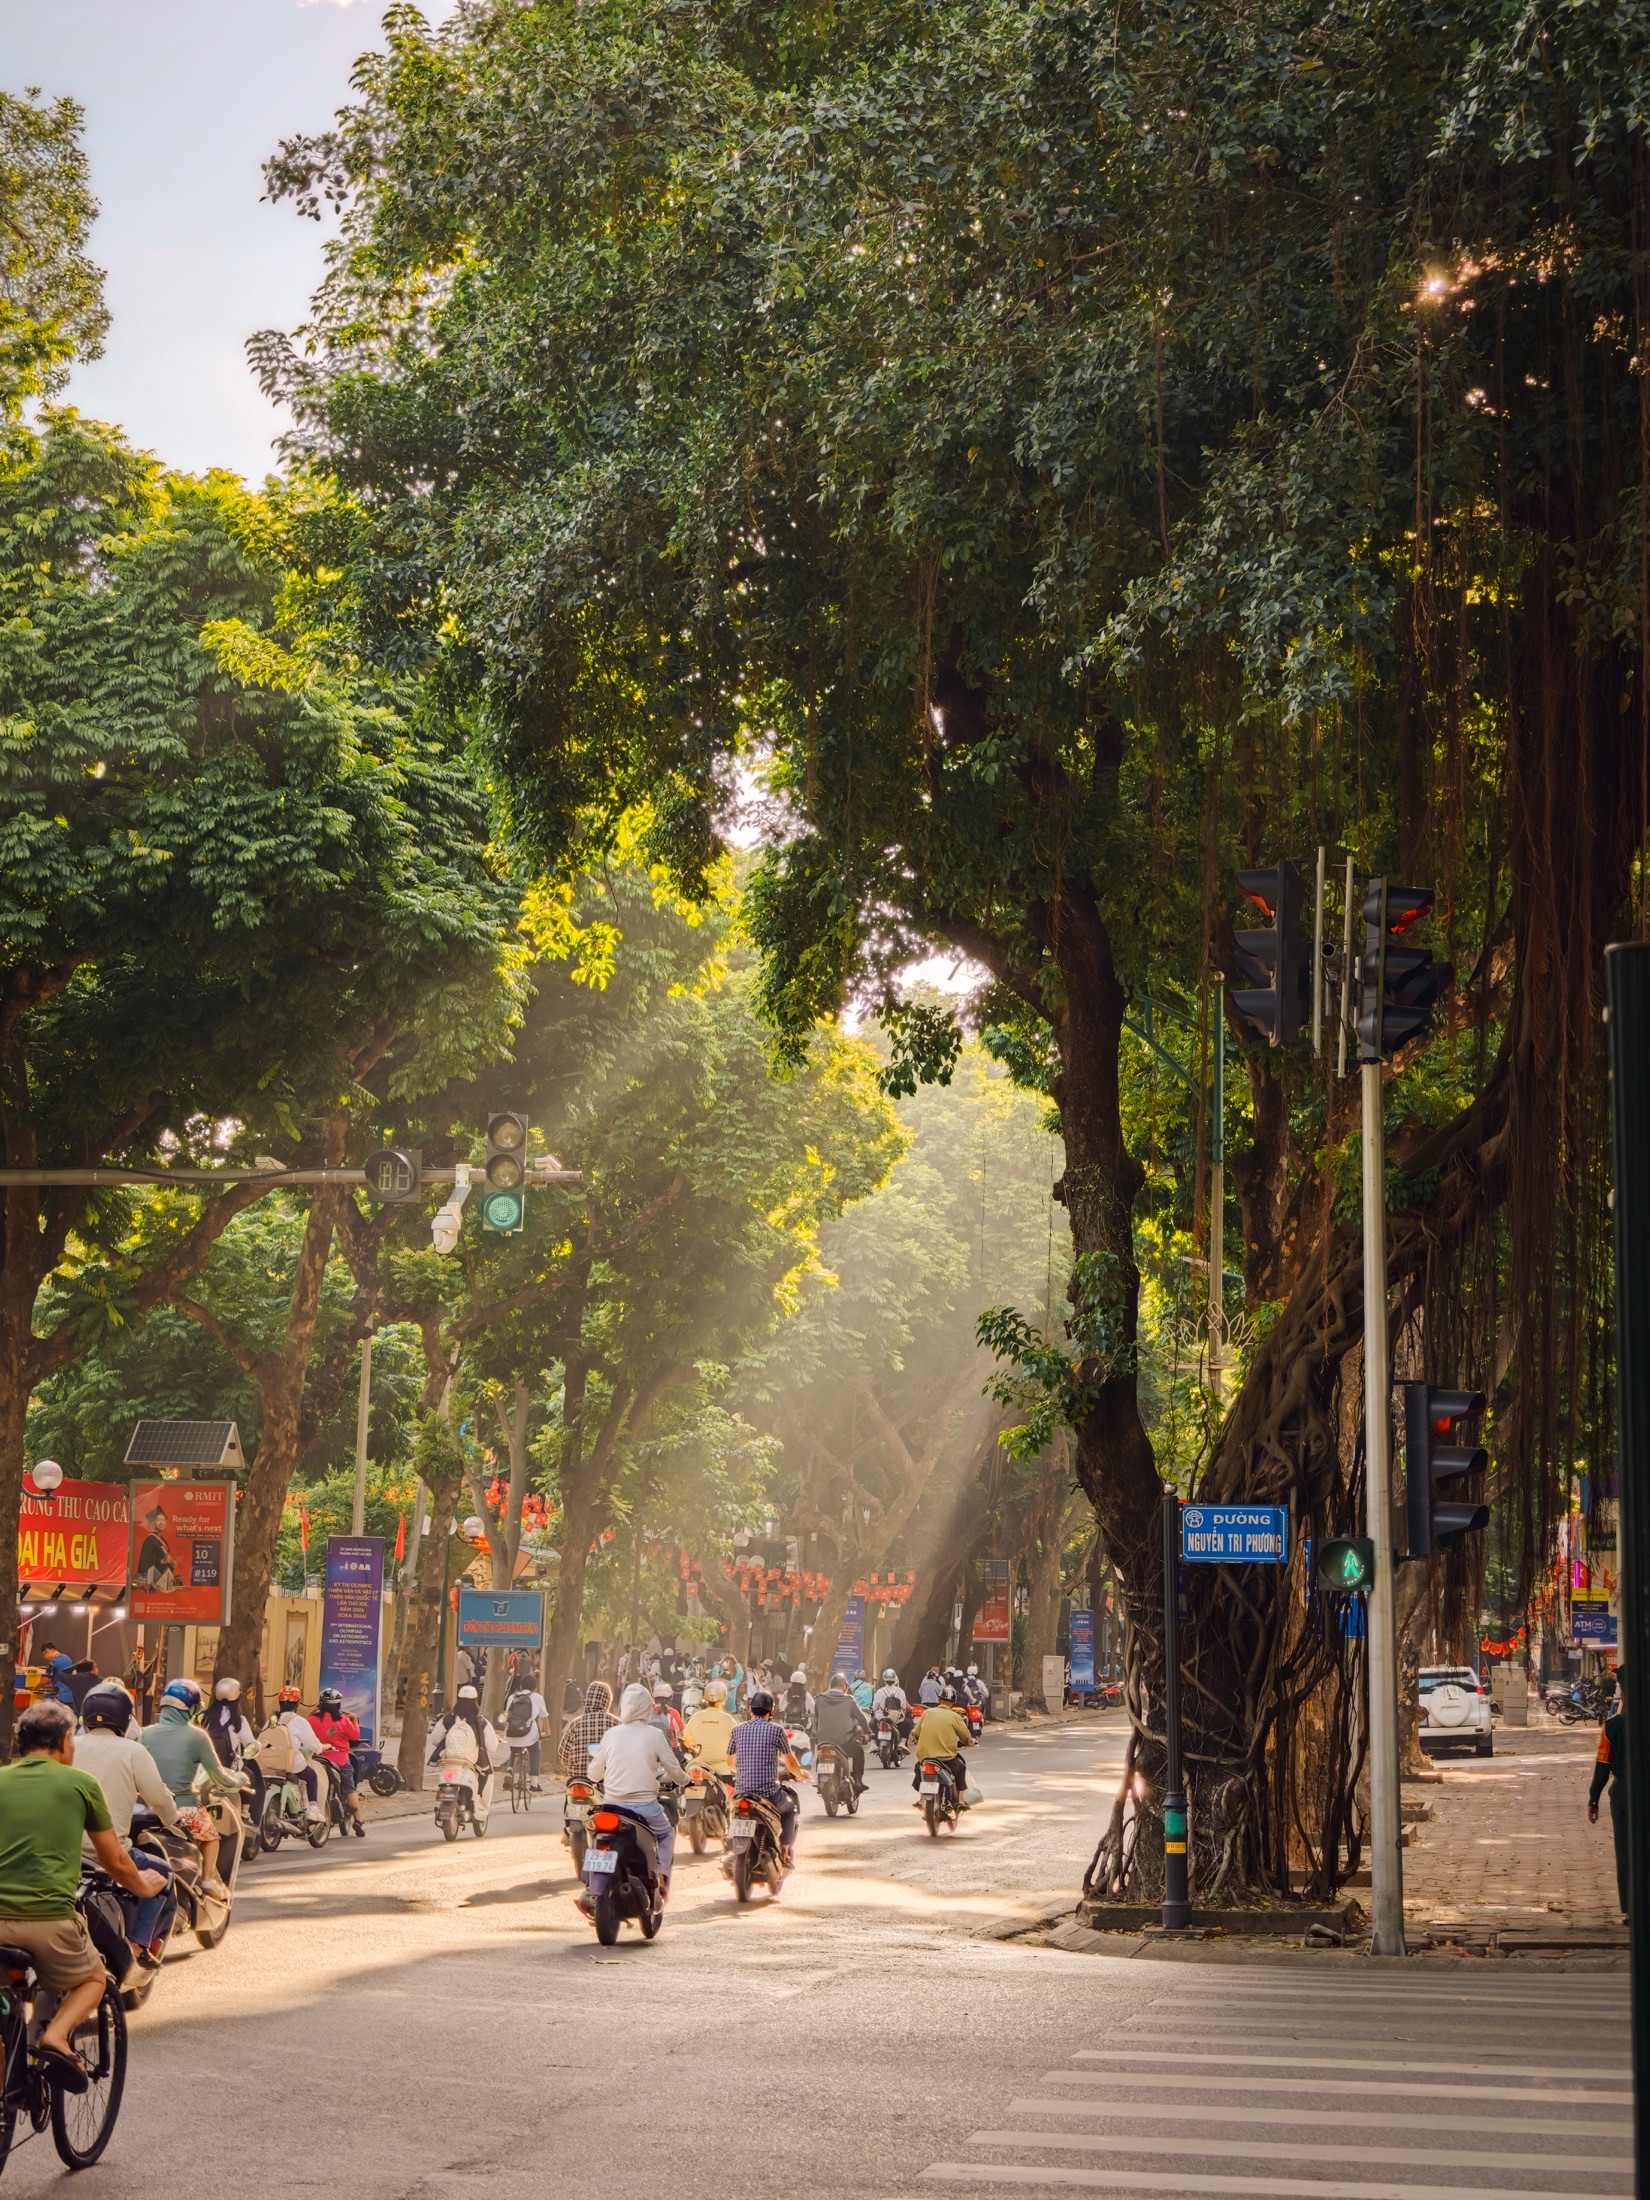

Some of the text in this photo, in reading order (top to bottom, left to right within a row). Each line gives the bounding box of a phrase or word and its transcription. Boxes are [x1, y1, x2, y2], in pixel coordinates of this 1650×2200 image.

[195, 1491, 224, 1501] RMIT
[56, 1495, 82, 1519] THU
[85, 1498, 110, 1522] CAO
[172, 1515, 197, 1524] Ready
[1213, 1511, 1271, 1524] ĐƯỜNG
[1187, 1526, 1281, 1553] NGUYỄN TRI PHƯƠNG
[43, 1531, 67, 1577] HẠ
[71, 1526, 99, 1571] GIÁ
[195, 1550, 208, 1559] 10
[194, 1569, 217, 1578] #119
